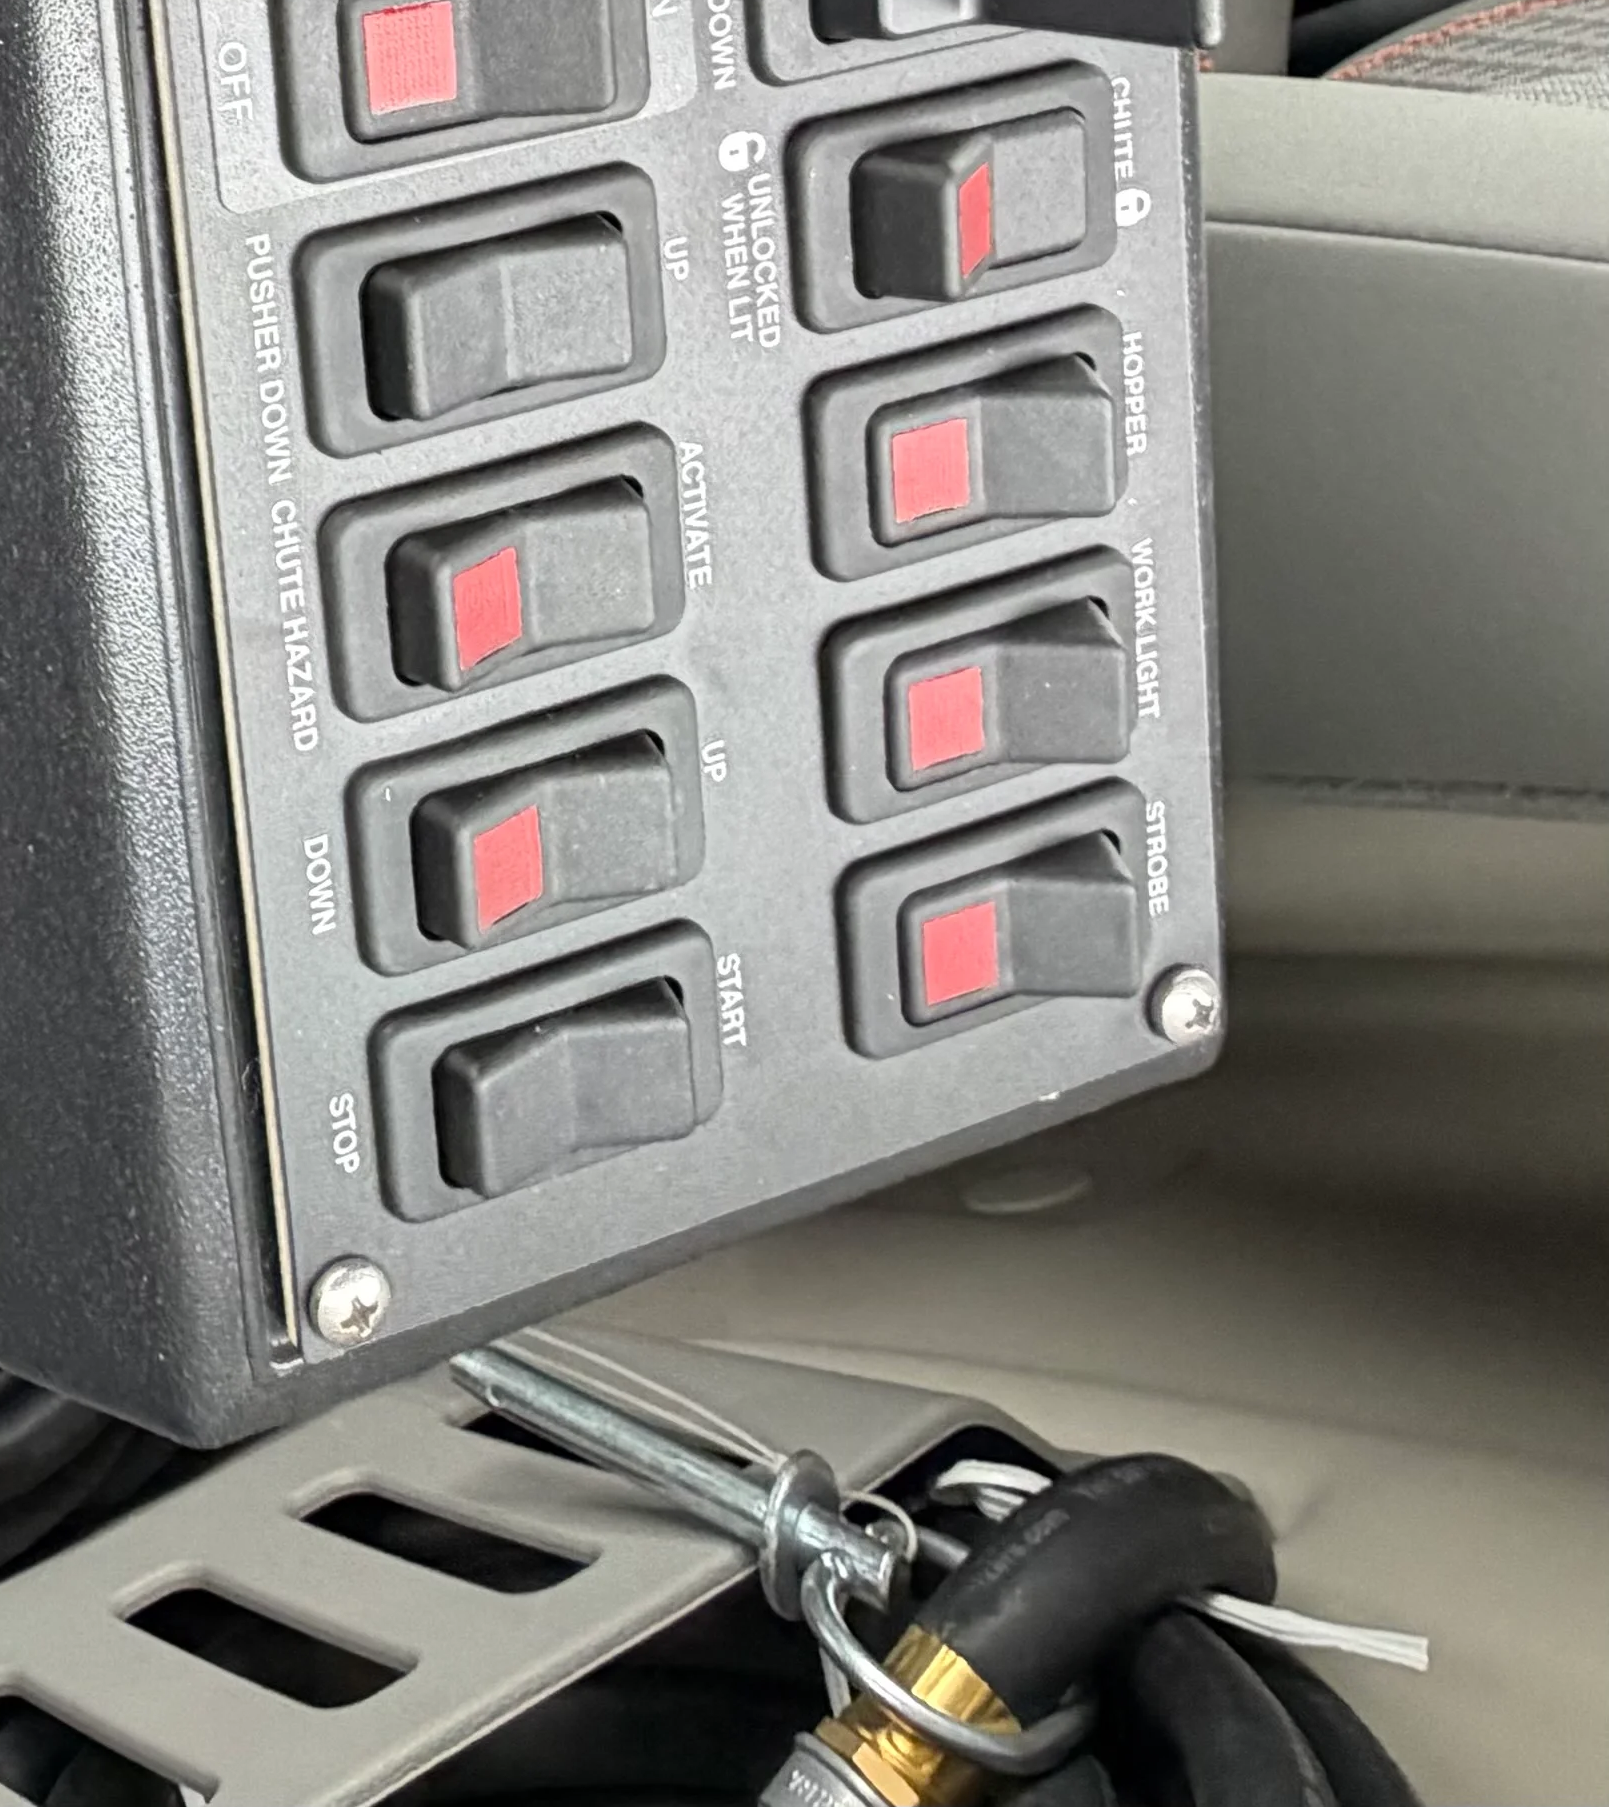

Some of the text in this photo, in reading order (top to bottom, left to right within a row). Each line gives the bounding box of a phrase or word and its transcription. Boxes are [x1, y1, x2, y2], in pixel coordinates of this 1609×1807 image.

[217, 41, 253, 121] OFF
[663, 236, 690, 280] UP
[721, 193, 759, 342] WHEN LIT
[748, 173, 781, 348] UNLOCKED
[245, 233, 292, 486] PUSHER DOWN
[1121, 332, 1147, 455] HOPPER
[680, 440, 713, 590] ACTIVATE
[271, 499, 318, 752] CHUTE HAZARD
[1130, 537, 1162, 719] WORK LIGHT
[700, 740, 726, 783] UP
[303, 833, 337, 935] DOWN
[1145, 801, 1170, 916] STROBE
[716, 953, 747, 1047] START
[329, 1093, 360, 1173] STOP
